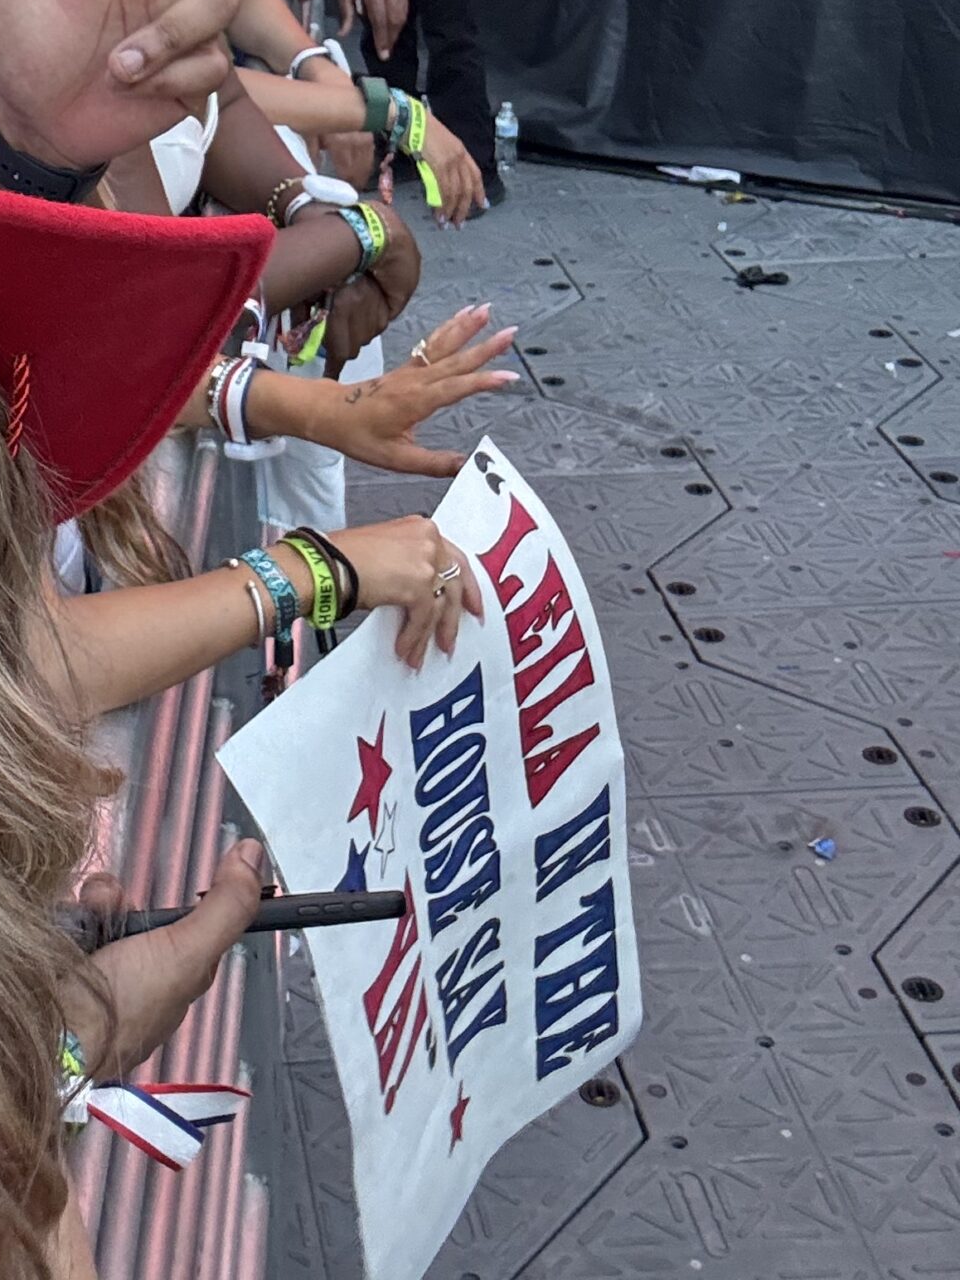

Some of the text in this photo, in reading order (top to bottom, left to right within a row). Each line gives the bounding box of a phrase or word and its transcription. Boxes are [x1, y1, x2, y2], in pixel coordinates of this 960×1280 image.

[318, 573, 333, 625] HONEY
[409, 660, 508, 1078] HOUSE SAY
[534, 782, 611, 903] IN
[533, 876, 620, 1083] THE
